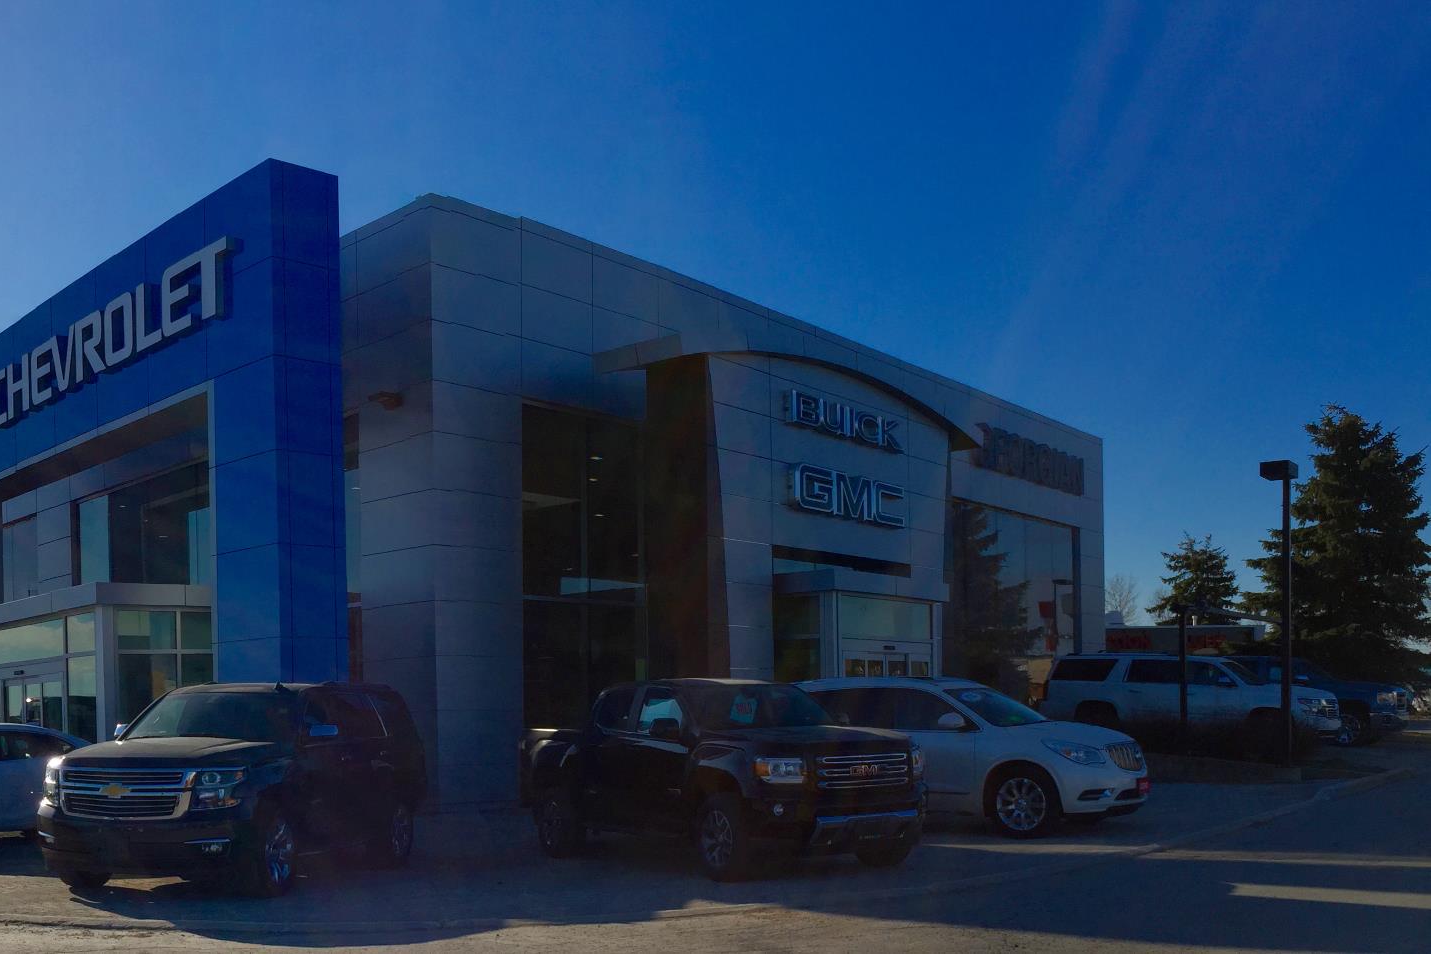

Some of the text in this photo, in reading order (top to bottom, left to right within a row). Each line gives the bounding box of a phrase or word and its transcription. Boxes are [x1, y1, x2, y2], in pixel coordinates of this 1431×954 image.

[791, 389, 905, 453] BUICK
[793, 463, 905, 528] GMC
[850, 764, 886, 777] GM
